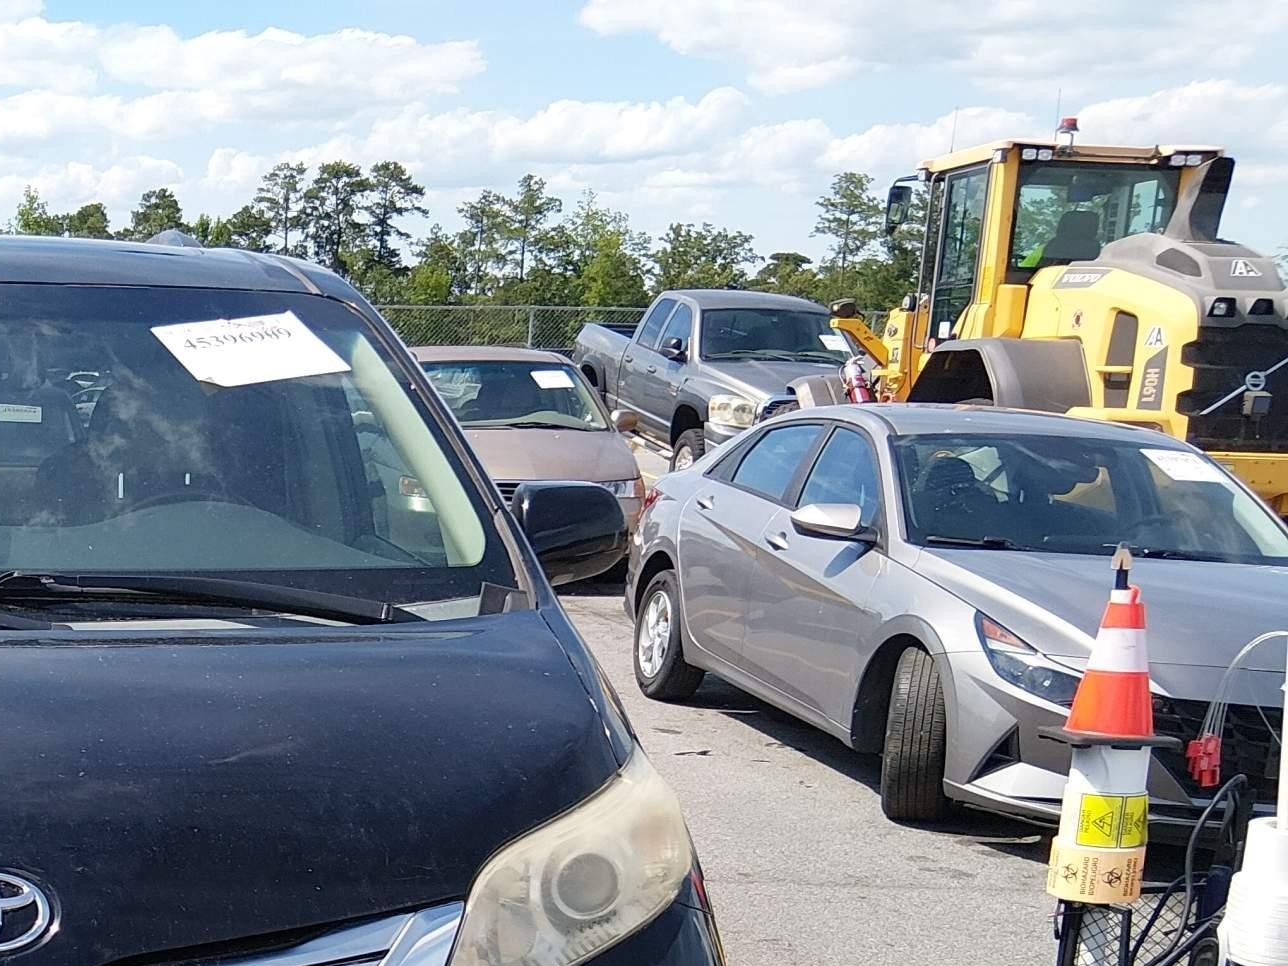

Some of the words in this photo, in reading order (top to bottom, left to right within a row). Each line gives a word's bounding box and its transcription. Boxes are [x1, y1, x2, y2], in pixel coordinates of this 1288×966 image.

[1141, 368, 1161, 402] L90H
[1079, 856, 1090, 895] BIOHAZARD
[1088, 857, 1099, 896] BIOPELIGRO
